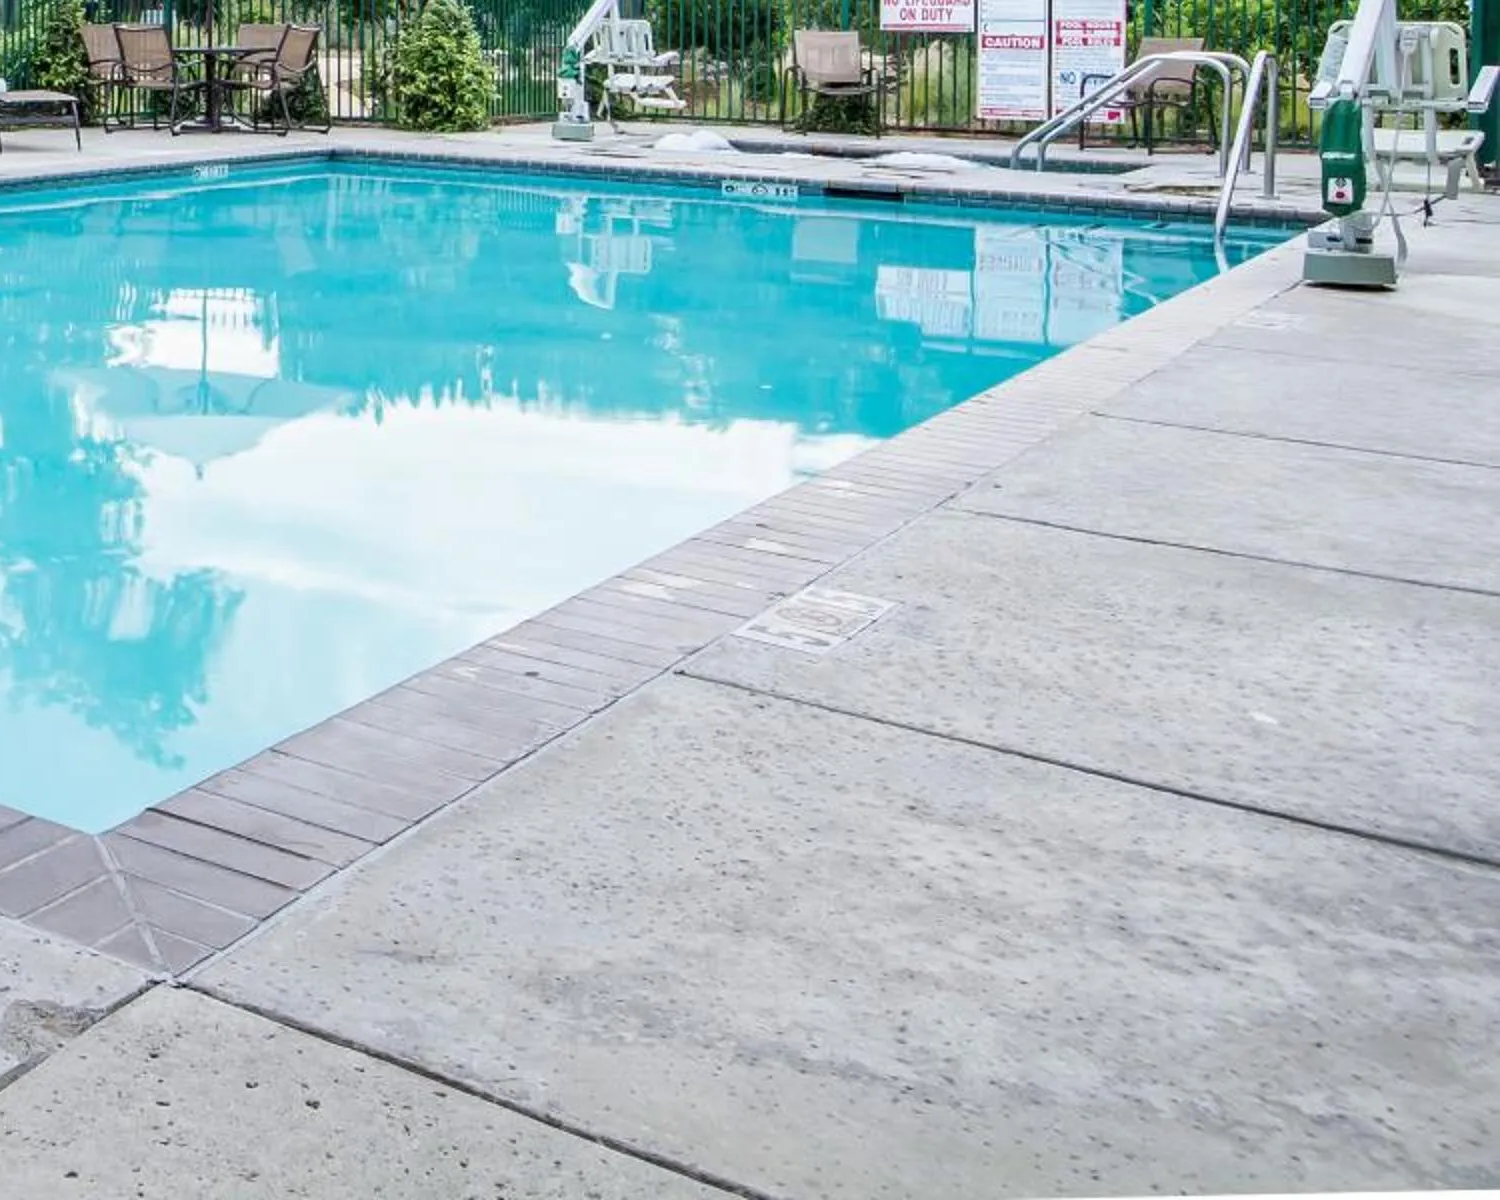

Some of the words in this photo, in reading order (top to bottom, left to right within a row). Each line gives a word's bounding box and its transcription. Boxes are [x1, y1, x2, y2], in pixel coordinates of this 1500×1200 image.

[900, 8, 916, 21] ON
[921, 8, 953, 22] DUTY
[985, 36, 1041, 49] CAUTION
[1060, 71, 1077, 84] NO
